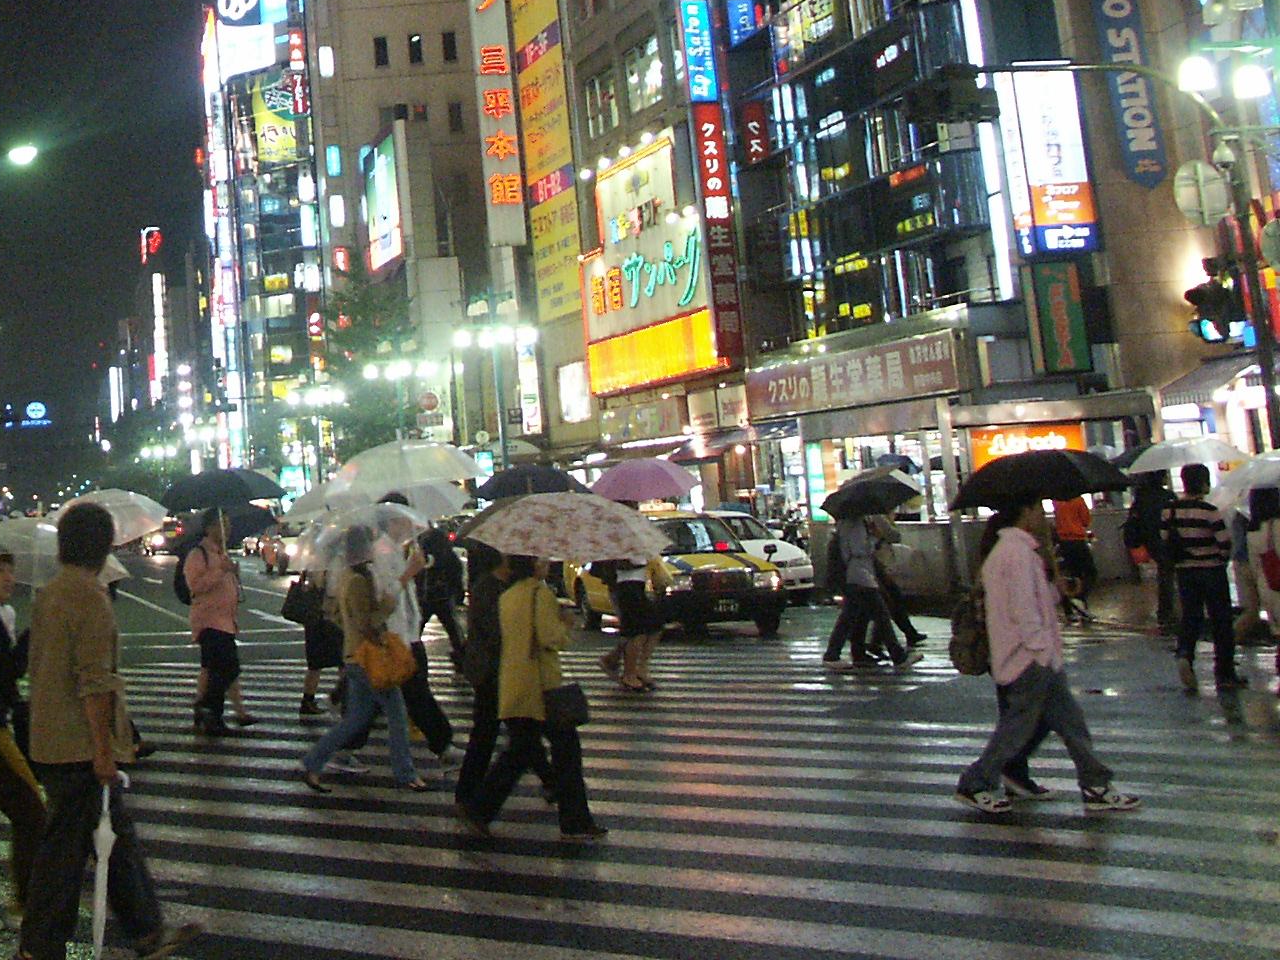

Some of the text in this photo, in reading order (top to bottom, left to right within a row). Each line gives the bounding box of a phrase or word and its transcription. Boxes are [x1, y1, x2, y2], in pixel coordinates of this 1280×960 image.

[684, 4, 705, 58] Salon
[1106, 27, 1158, 153] STATION
[479, 44, 524, 207] 三平本館
